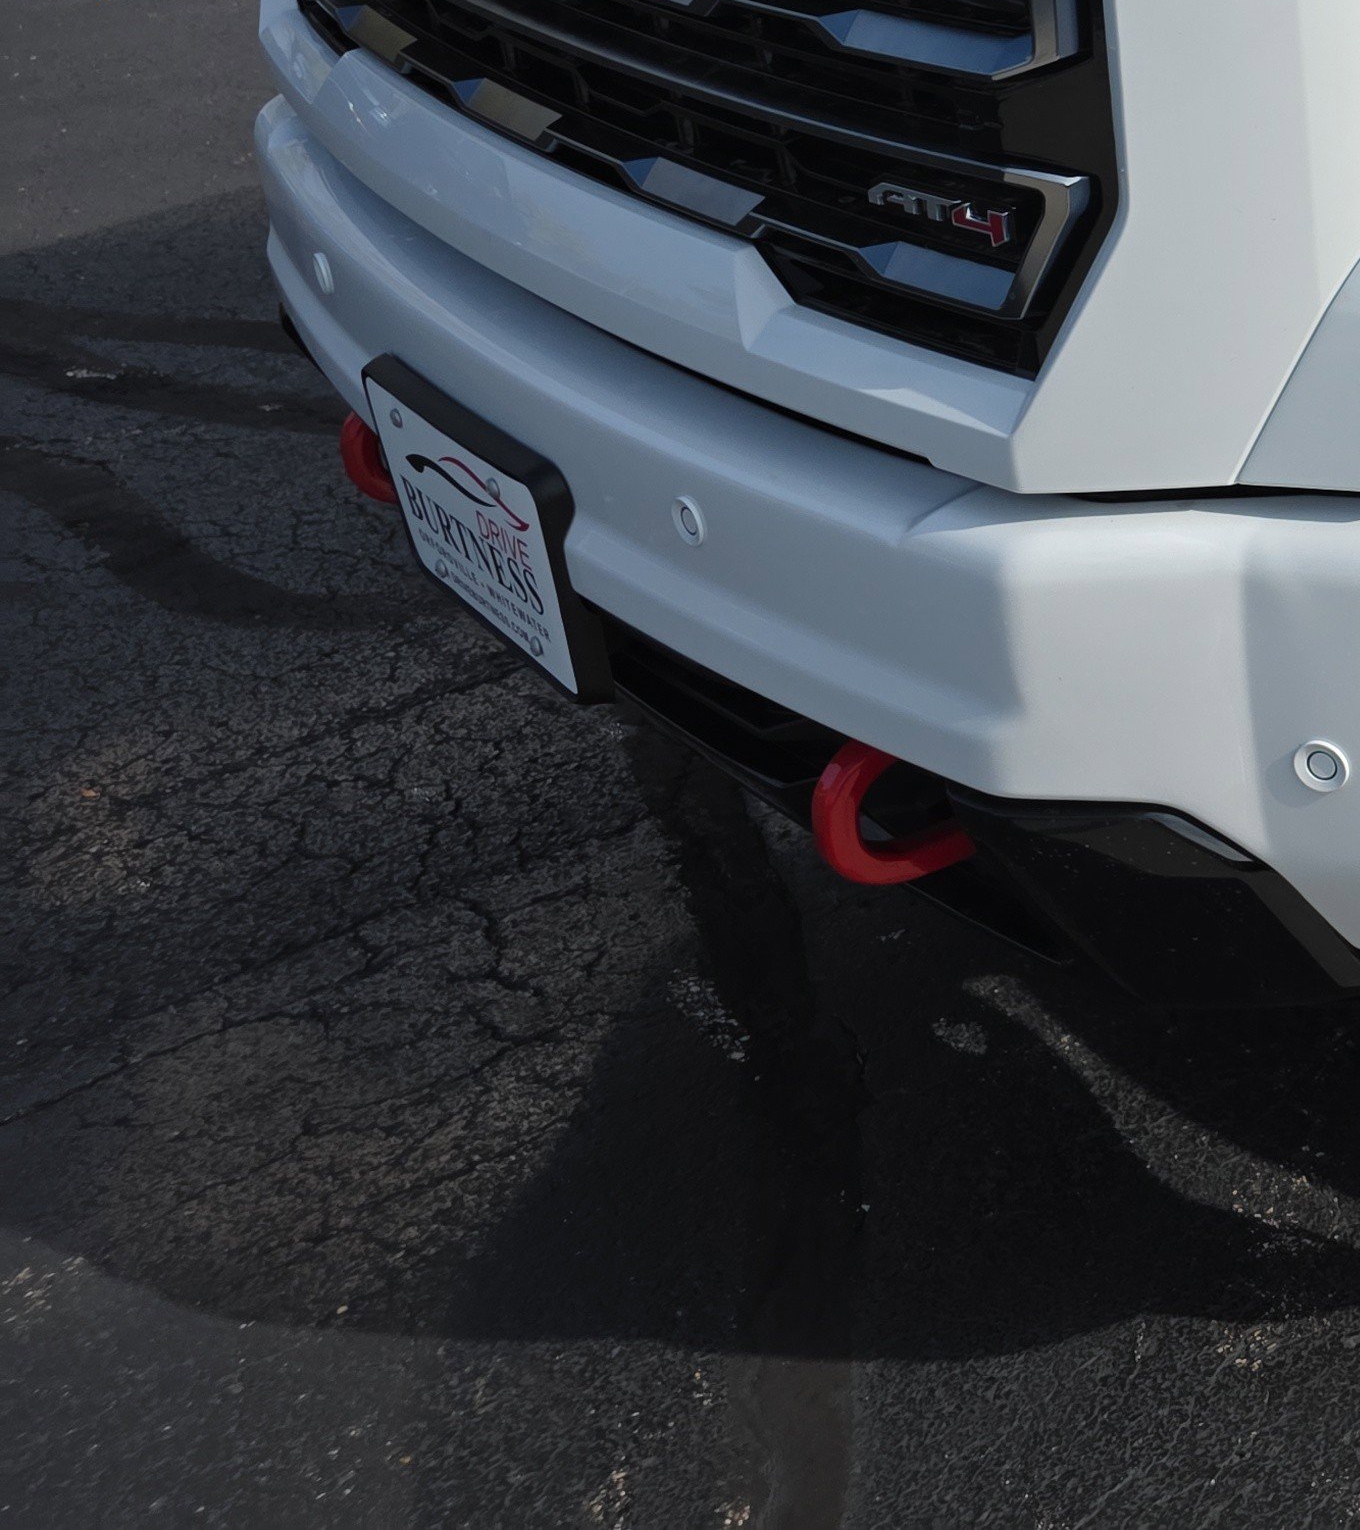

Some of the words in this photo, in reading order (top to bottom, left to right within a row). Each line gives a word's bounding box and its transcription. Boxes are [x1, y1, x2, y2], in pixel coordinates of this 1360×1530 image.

[867, 182, 1016, 248] AT4
[401, 474, 545, 616] BURTNESS
[475, 510, 533, 572] DRIVE
[486, 583, 552, 643] WHITEWATER
